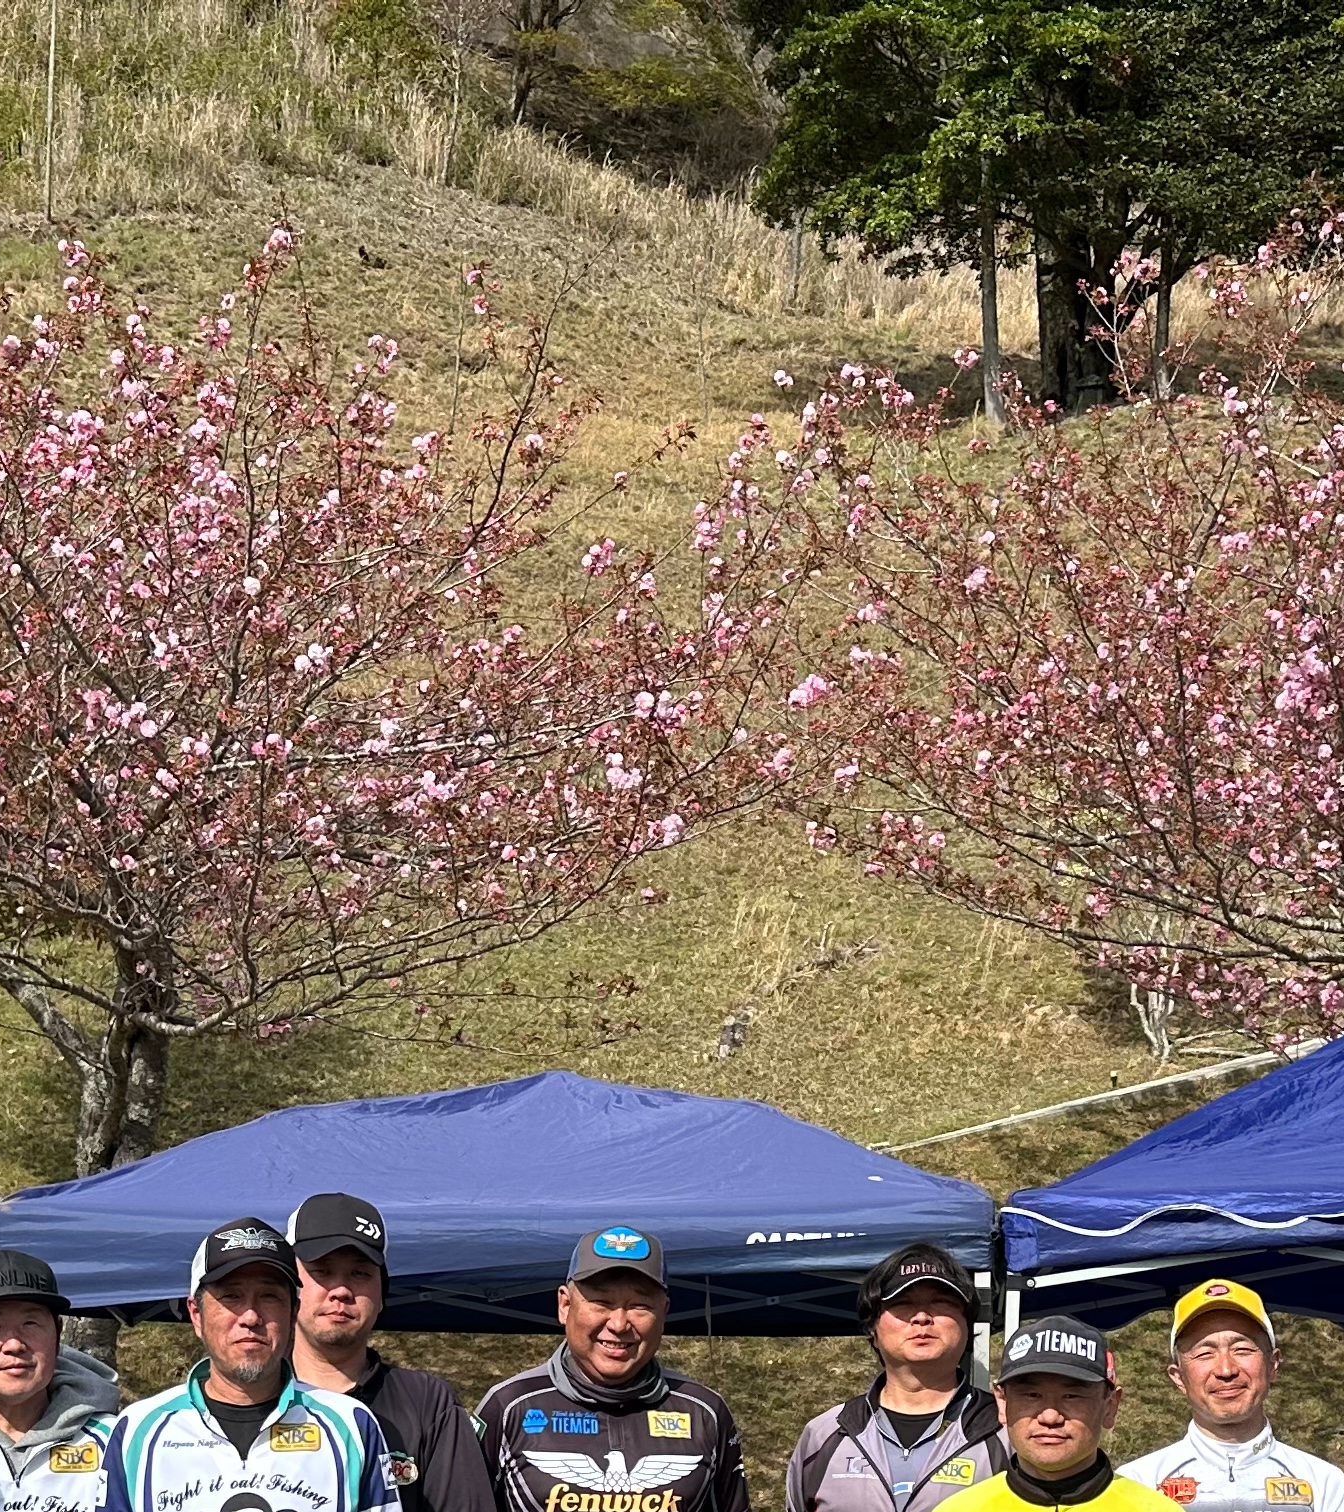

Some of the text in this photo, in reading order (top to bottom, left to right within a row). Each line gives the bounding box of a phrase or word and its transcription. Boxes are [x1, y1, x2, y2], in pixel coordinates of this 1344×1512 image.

[1036, 1329, 1097, 1361] TIEMCO
[551, 1417, 599, 1434] TIEMCO
[654, 1416, 687, 1432] NBC
[276, 1430, 316, 1445] NBC
[56, 1449, 93, 1465] NBC
[937, 1463, 970, 1478] NBC
[157, 1474, 332, 1512] Fight it out! Fishing
[1273, 1482, 1307, 1498] NBC
[3, 1495, 38, 1511] out!
